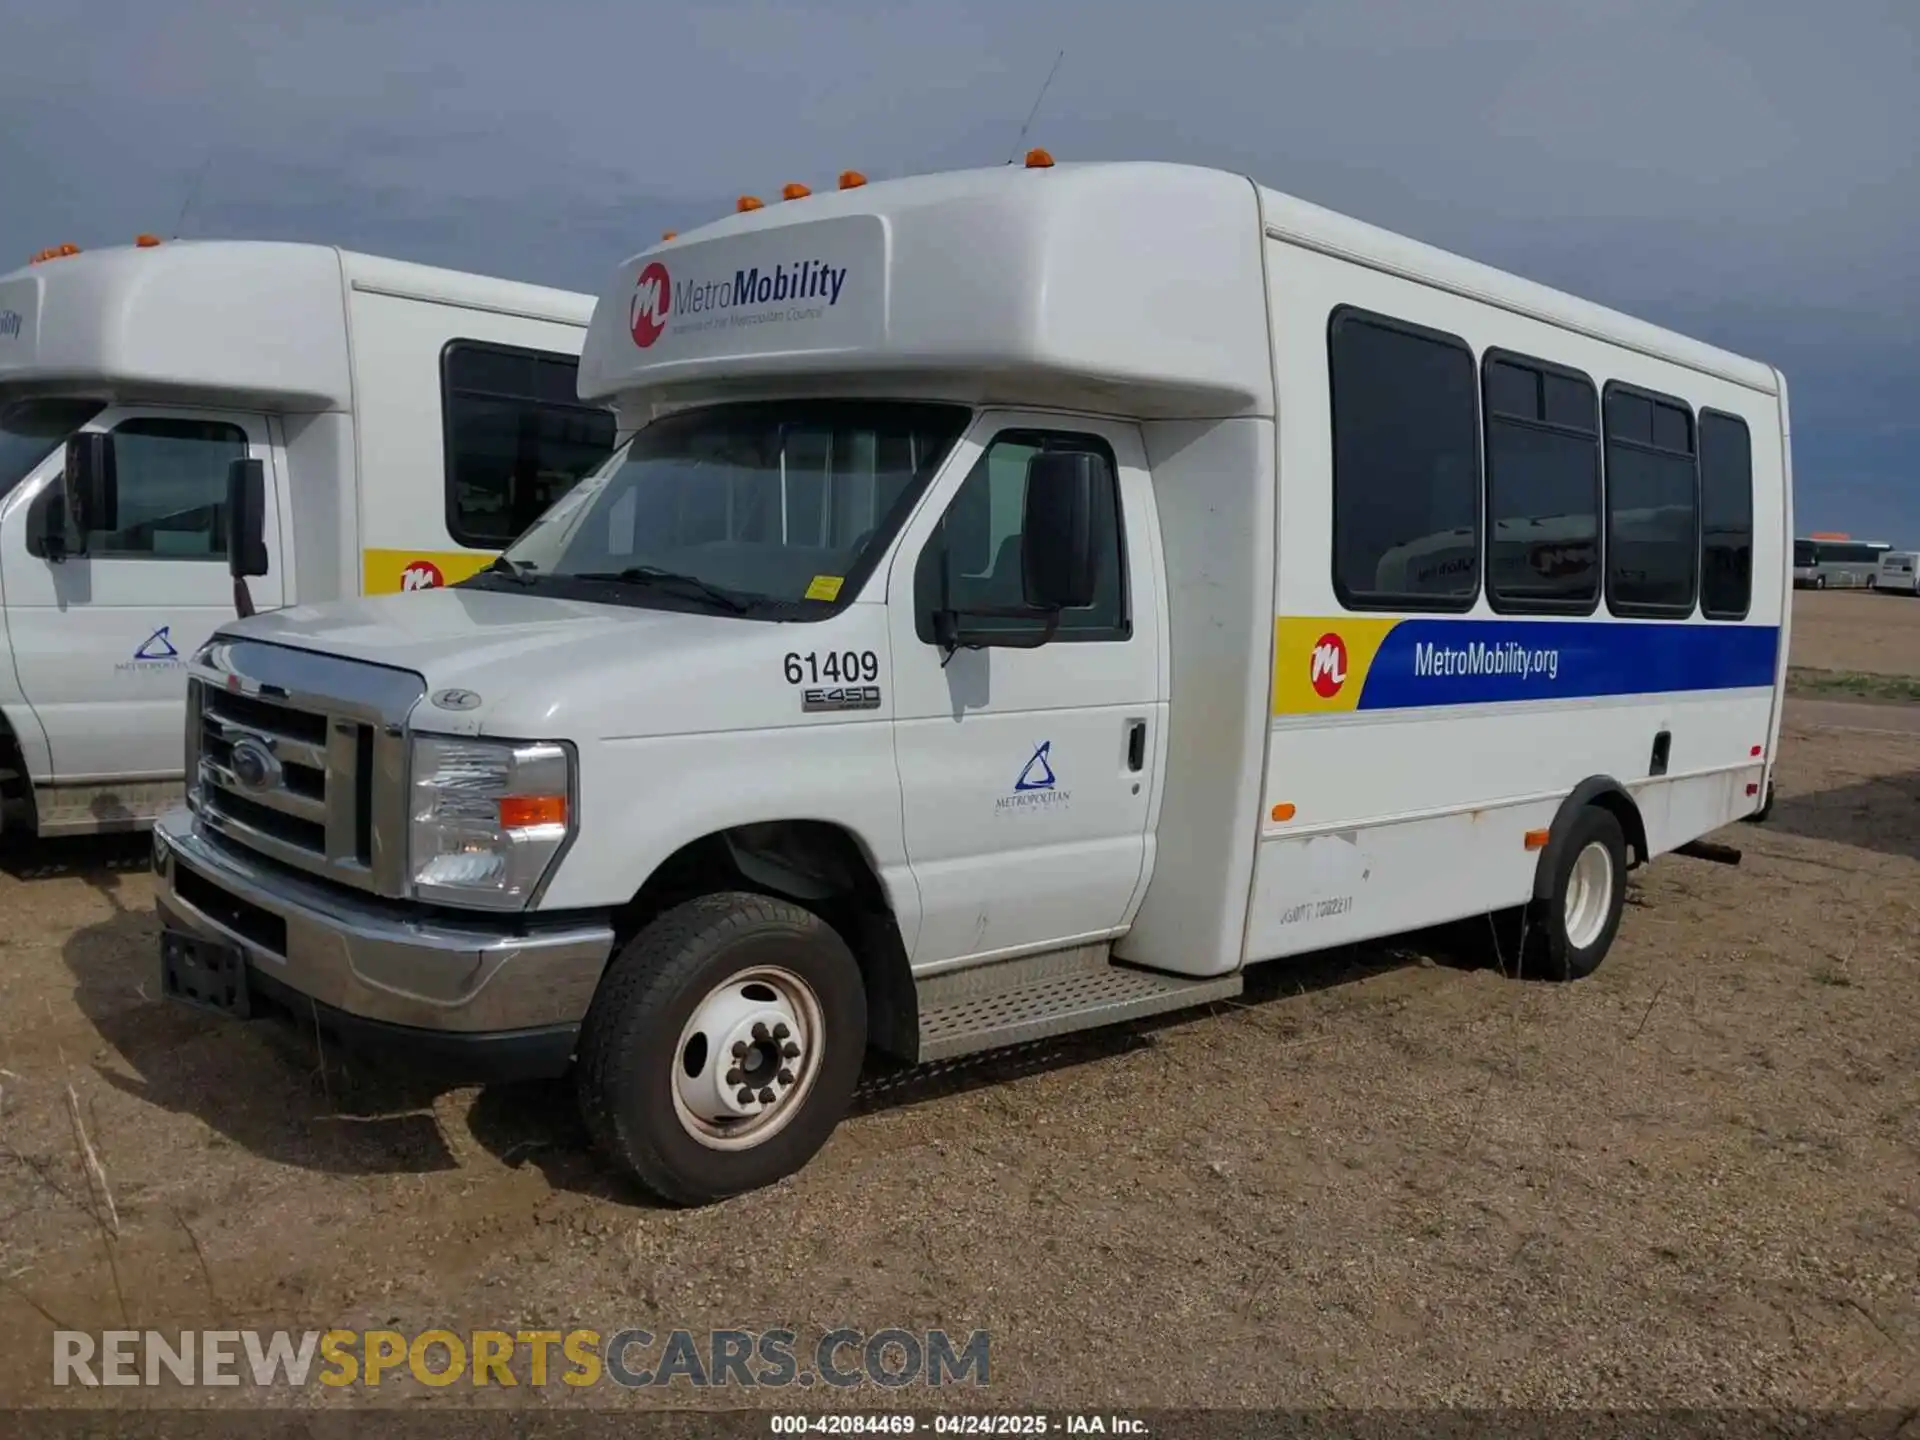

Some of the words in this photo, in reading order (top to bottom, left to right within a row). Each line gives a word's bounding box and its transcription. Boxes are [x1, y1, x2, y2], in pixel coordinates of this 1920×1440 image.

[673, 259, 847, 316] MetroMobility
[784, 650, 879, 684] 61409
[1415, 642, 1558, 679] MetroMobility.org
